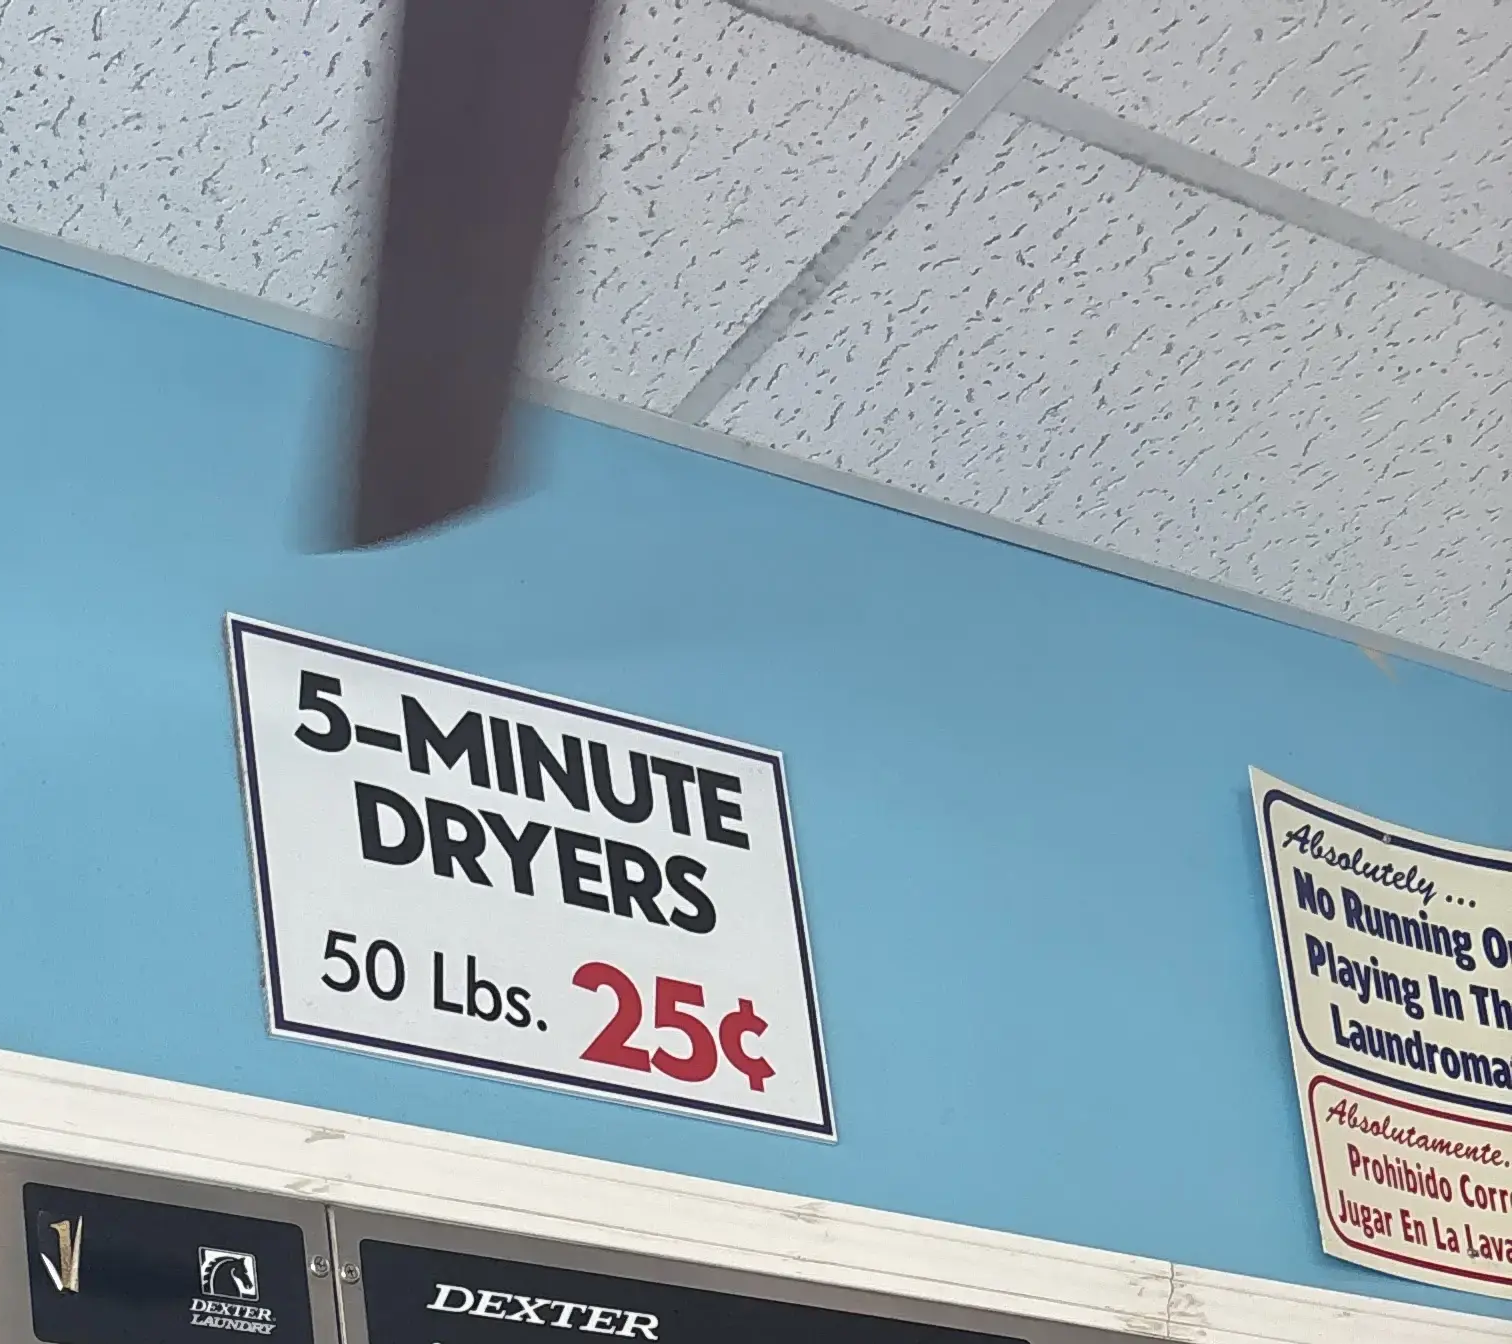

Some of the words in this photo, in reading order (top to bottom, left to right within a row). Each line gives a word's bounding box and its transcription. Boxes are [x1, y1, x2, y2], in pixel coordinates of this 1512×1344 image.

[295, 670, 750, 850] 5-MINUTE
[354, 781, 716, 934] DRYERS
[1282, 824, 1437, 906] Absolutely
[1293, 867, 1335, 920] No
[1341, 886, 1476, 971] Running
[1482, 927, 1512, 968] O
[321, 930, 405, 1001] 50
[433, 951, 548, 1032] Lbs.
[572, 962, 776, 1093] 25¢
[1305, 933, 1424, 1020] Playing
[1428, 974, 1464, 1021] In
[1330, 1002, 1512, 1090] Laundroma
[1347, 1142, 1452, 1203] Prohibido
[1460, 1174, 1512, 1214] Corr
[1339, 1189, 1392, 1240] Jugar
[1400, 1209, 1427, 1247] En
[1432, 1216, 1459, 1259] La
[189, 1298, 273, 1321] DEXTER
[190, 1313, 276, 1335] LAUNDRY
[426, 1283, 660, 1340] DEXTER
